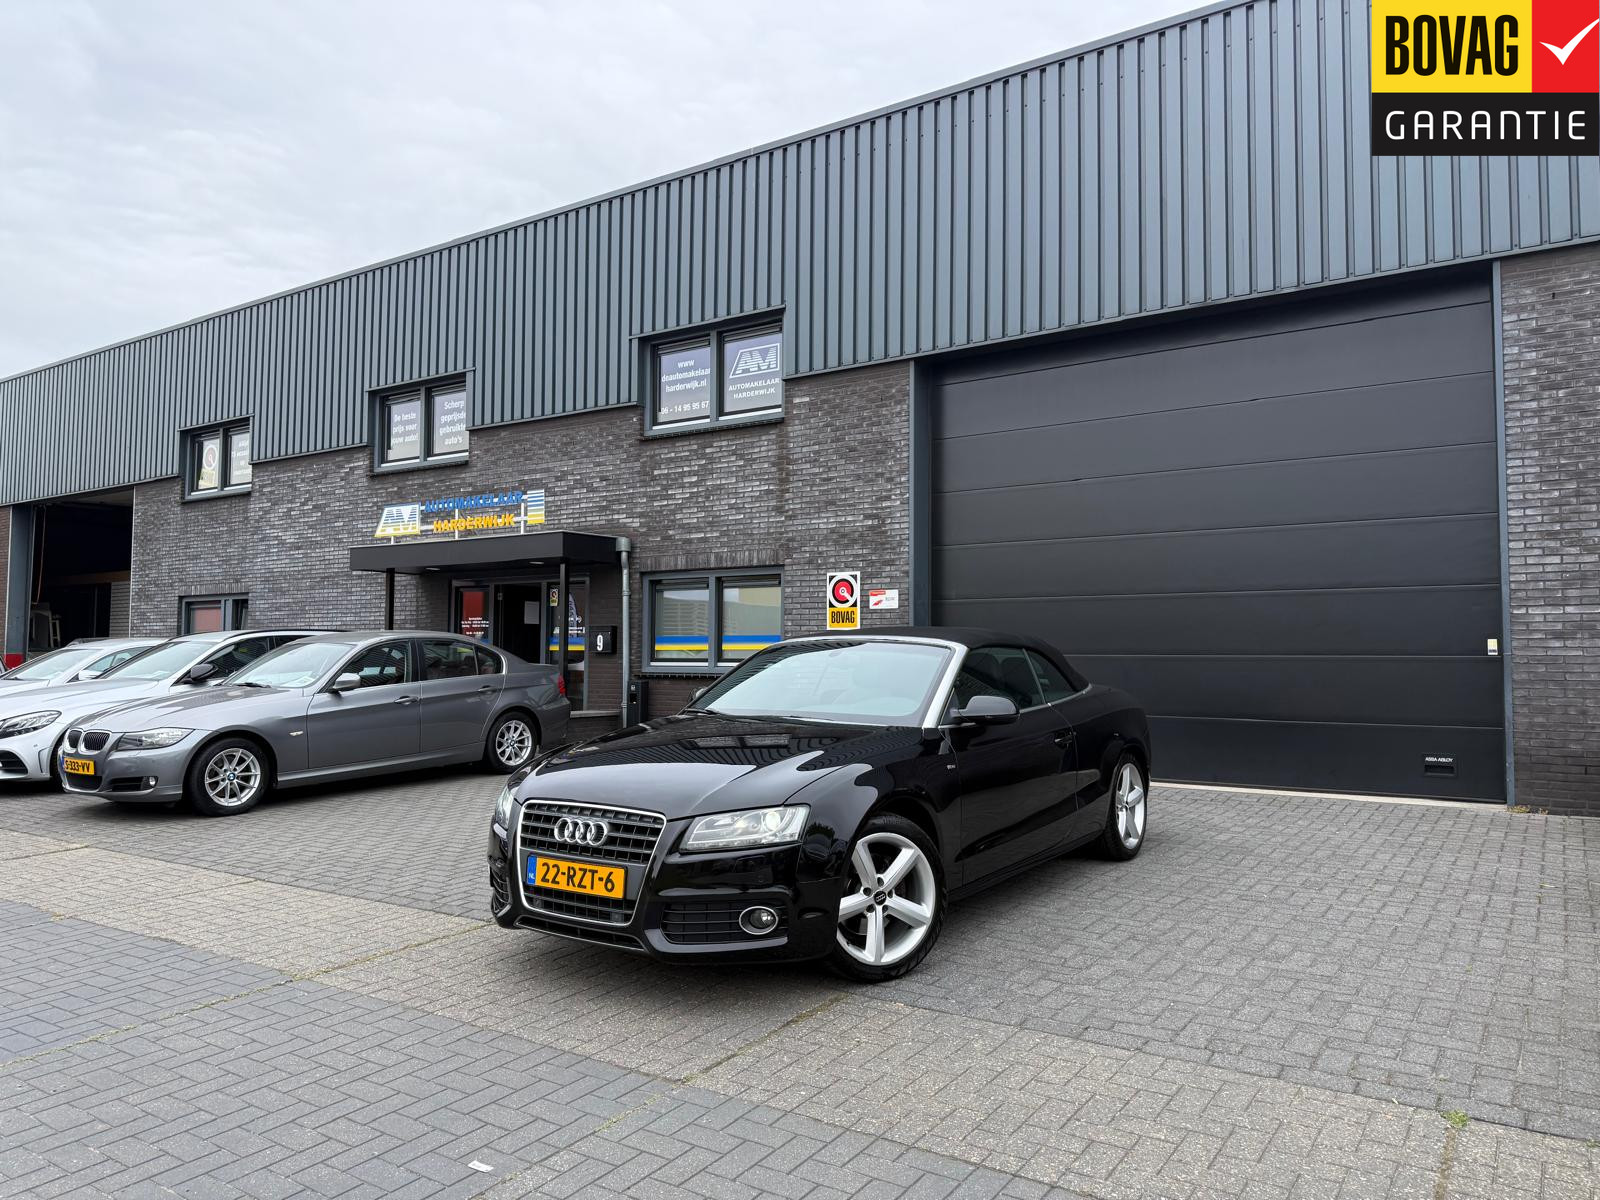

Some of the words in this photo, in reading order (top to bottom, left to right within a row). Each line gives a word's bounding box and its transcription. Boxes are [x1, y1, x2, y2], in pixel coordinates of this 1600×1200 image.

[677, 359, 695, 368] www
[665, 378, 707, 393] harderwijk.nl
[728, 377, 780, 391] AUTOMAKELAAR
[733, 387, 776, 399] HARDERWIJK
[674, 404, 682, 413] 14
[682, 403, 691, 411] 95
[692, 402, 700, 410] 95
[401, 411, 417, 421] beste
[392, 424, 405, 435] prijs
[405, 423, 417, 431] voor
[424, 490, 524, 513] AUTOMAKELAAR
[432, 513, 515, 533] HARDERWIJK
[831, 610, 855, 624] BOVAG
[596, 634, 604, 652] 9
[540, 862, 616, 893] 22-RZT-6
